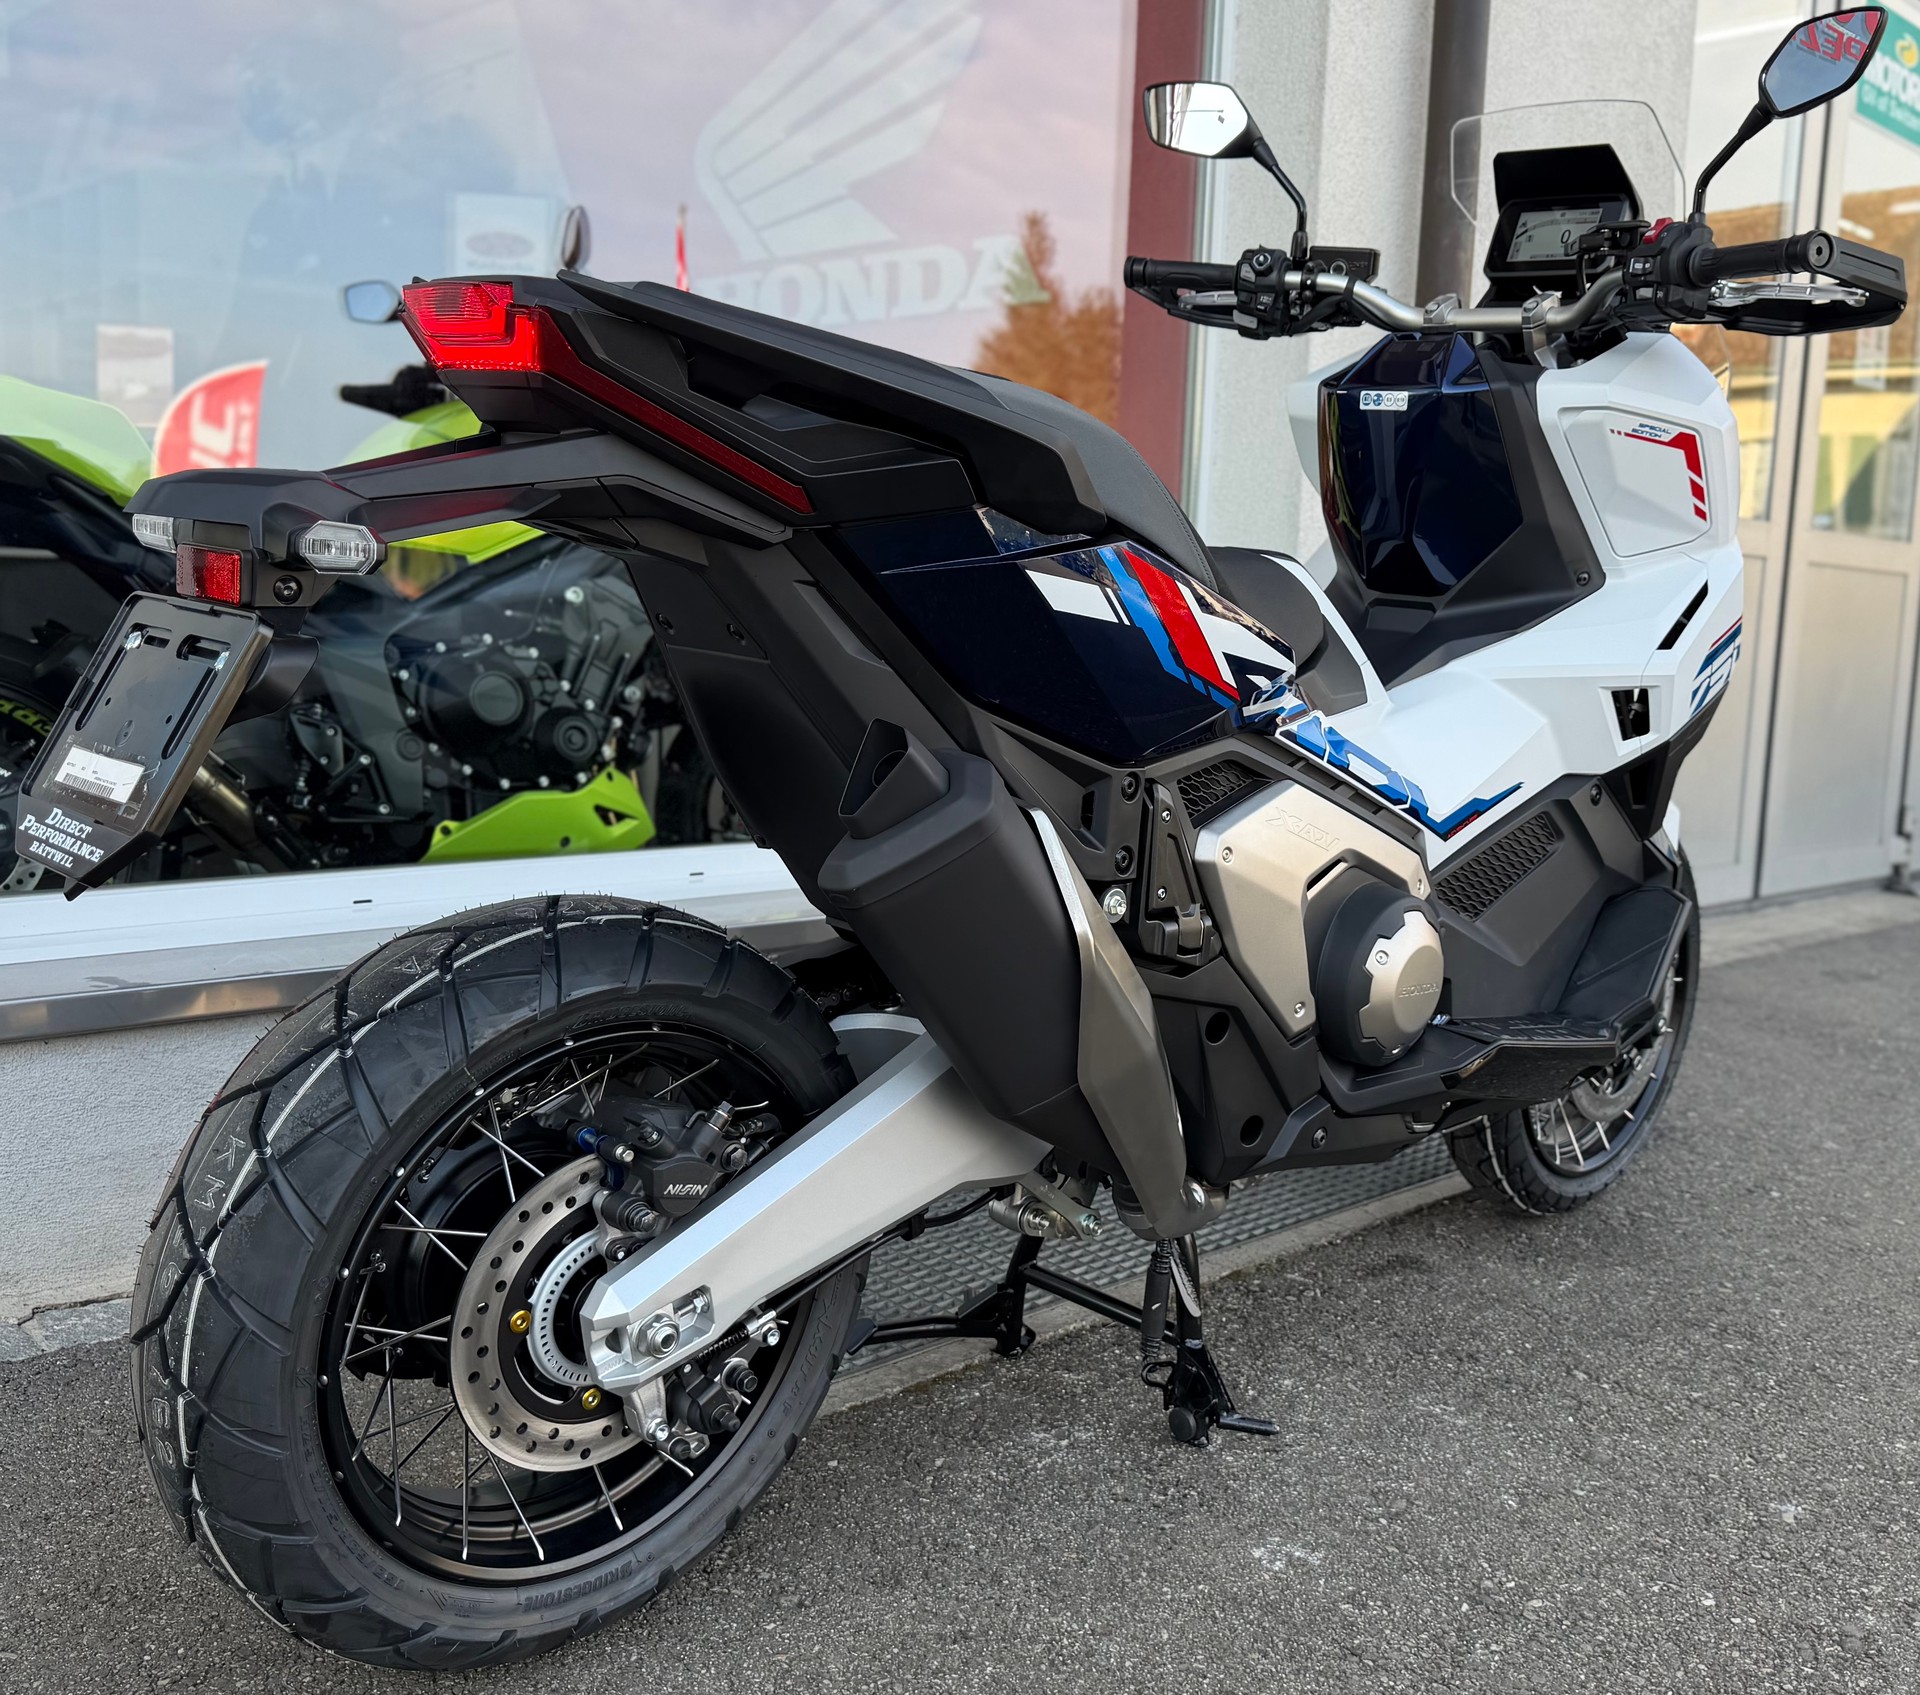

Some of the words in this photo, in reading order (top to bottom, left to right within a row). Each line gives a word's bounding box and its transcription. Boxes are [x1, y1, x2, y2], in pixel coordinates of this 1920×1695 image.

[696, 234, 1050, 327] HONDA
[18, 813, 104, 863] PERFORMANCE
[45, 807, 93, 839] DIRECT
[522, 1558, 634, 1612] BRIDGESTONE
